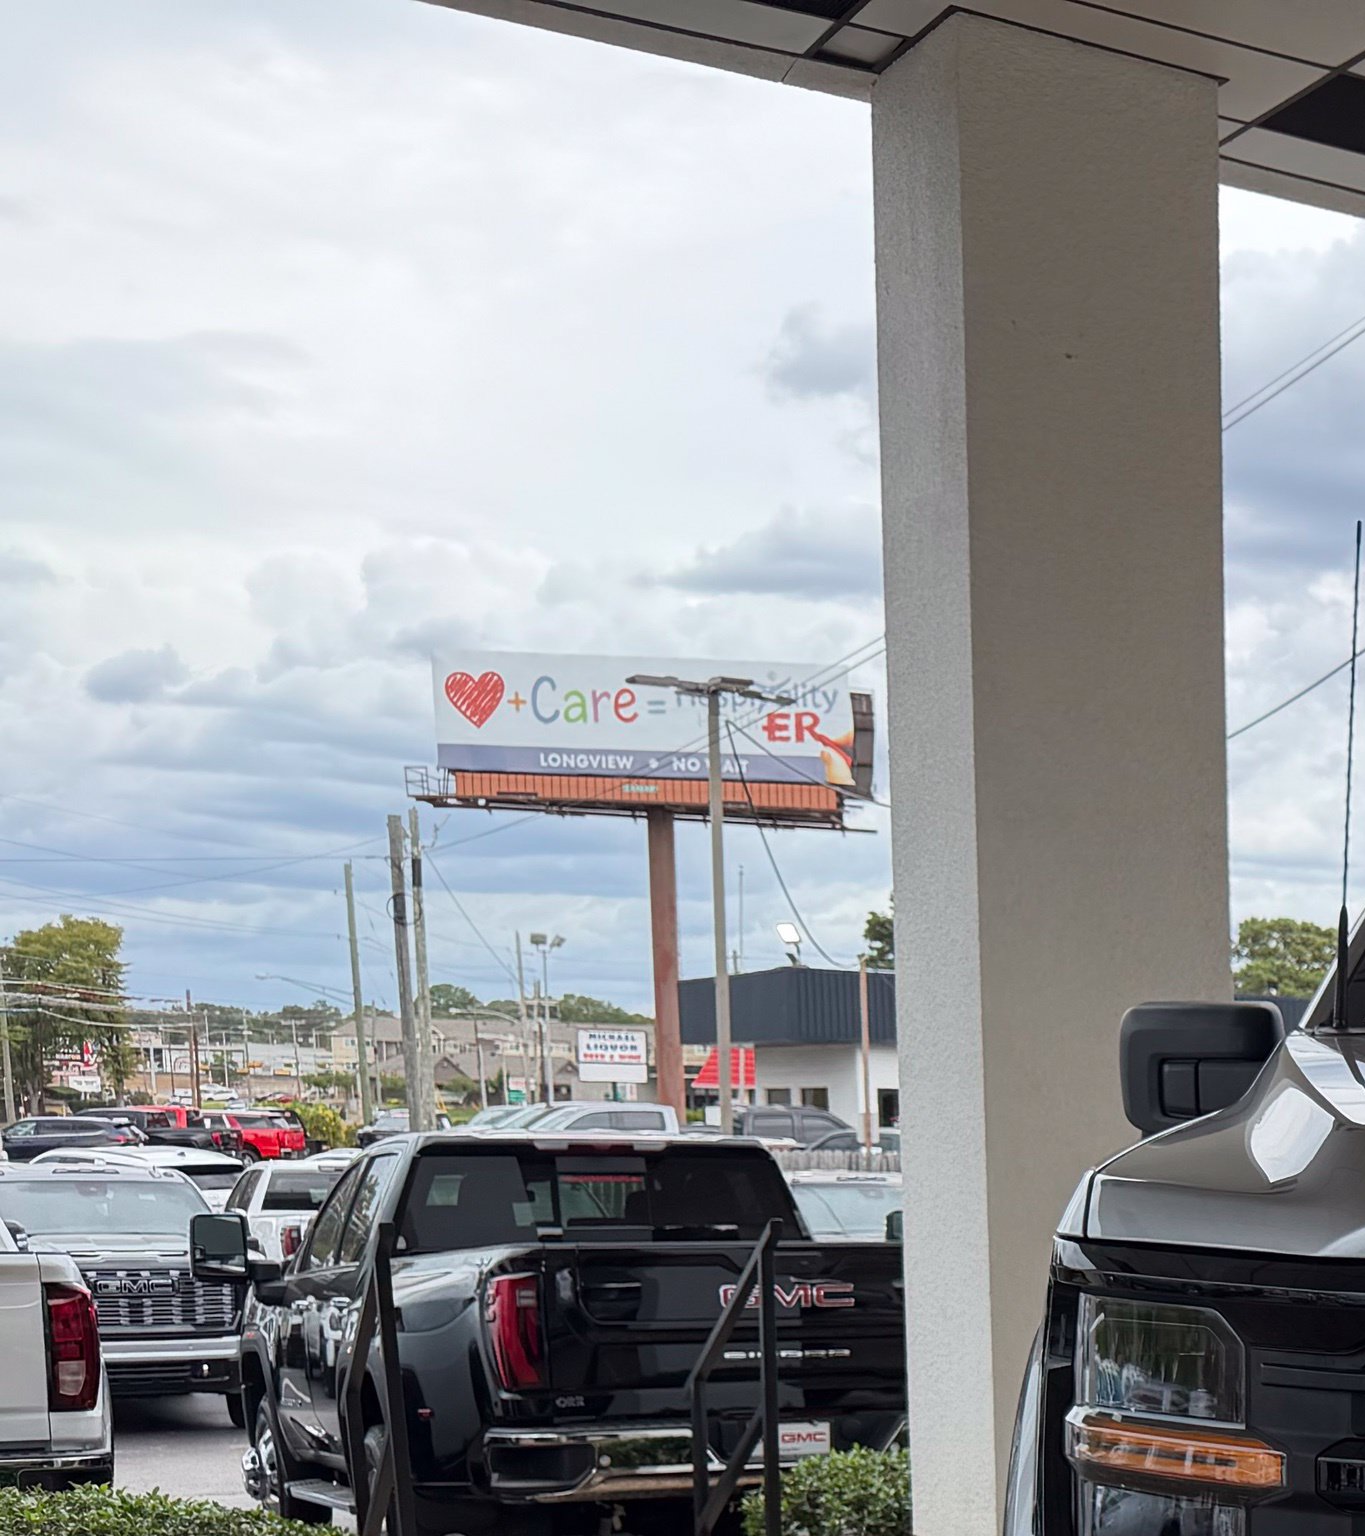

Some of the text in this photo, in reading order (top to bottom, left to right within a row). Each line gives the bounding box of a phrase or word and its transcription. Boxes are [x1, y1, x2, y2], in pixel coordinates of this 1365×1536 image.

[531, 675, 638, 725] Care
[762, 711, 821, 743] ER
[540, 752, 749, 774] LONGVIEW NO AIT
[97, 1279, 172, 1293] GMC
[719, 1283, 855, 1308] GMC
[781, 1431, 826, 1443] GMC
